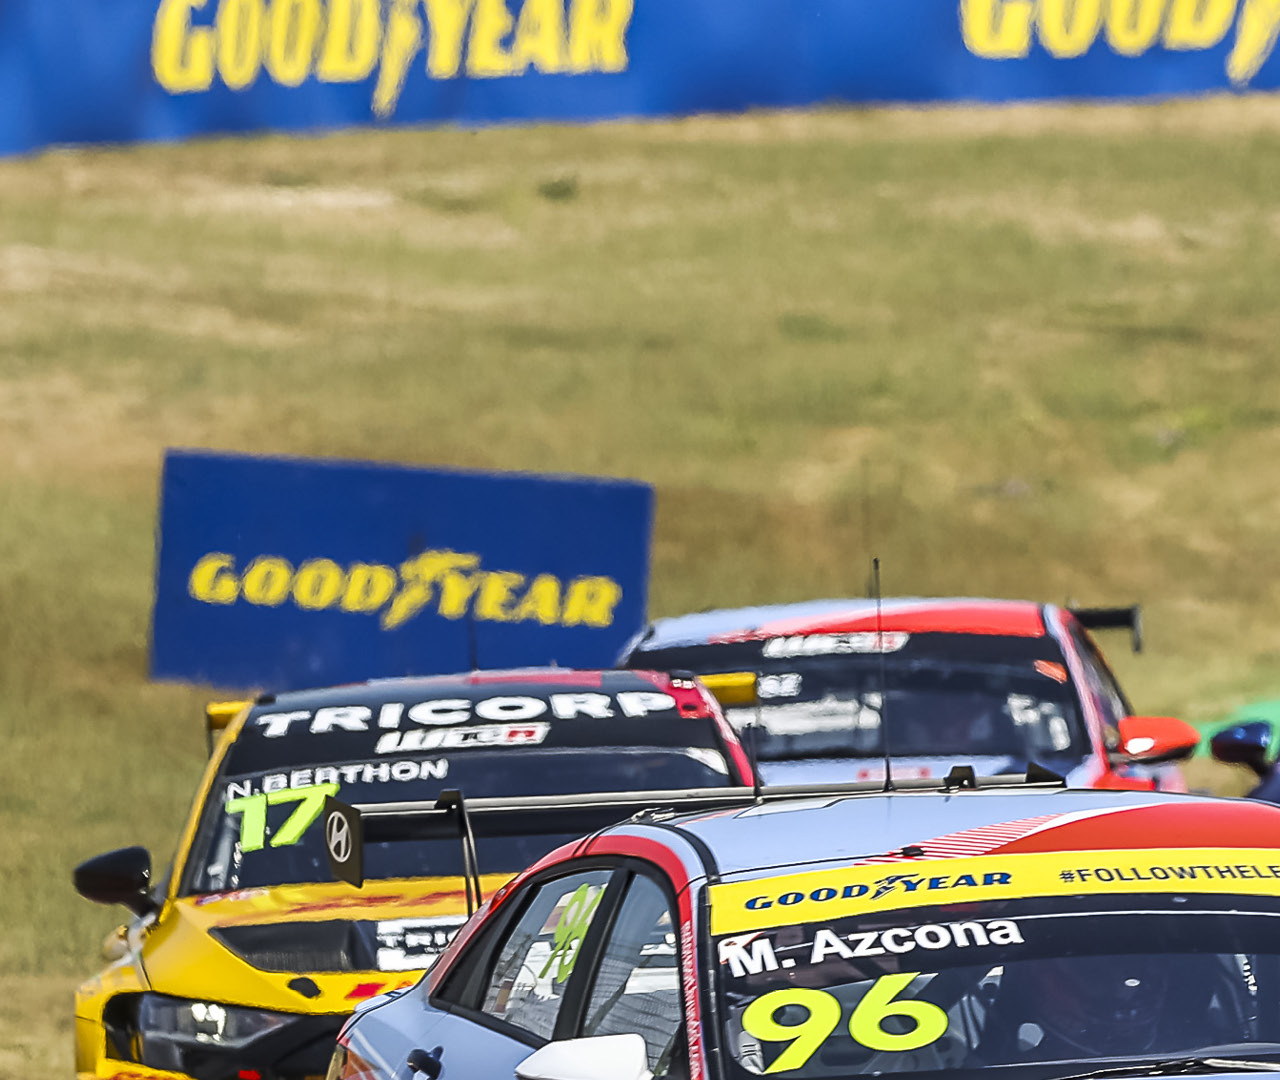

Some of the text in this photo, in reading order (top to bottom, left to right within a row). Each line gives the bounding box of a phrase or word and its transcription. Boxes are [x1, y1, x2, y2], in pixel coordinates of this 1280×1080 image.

[152, 0, 633, 93] GOODYEAR
[189, 550, 622, 630] GOODYEAR
[256, 691, 676, 738] TRICORP
[225, 783, 341, 853] 17
[745, 871, 1013, 911] GOODYEAR
[727, 919, 1025, 978] M. Azcona
[742, 971, 949, 1074] 96
